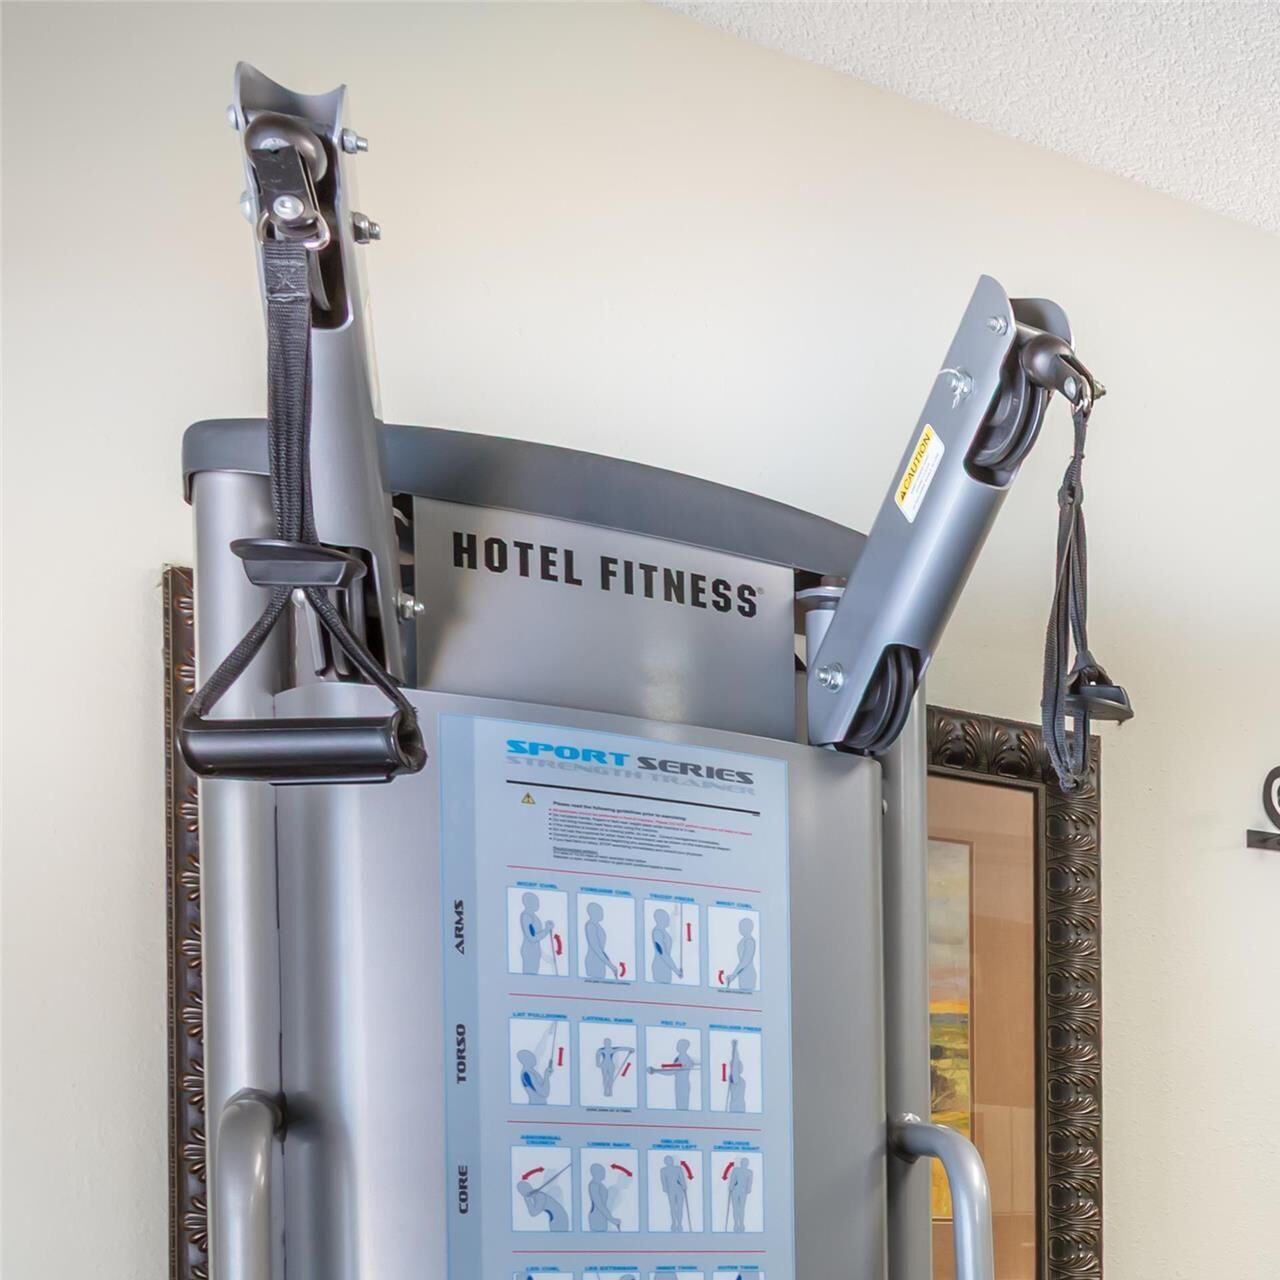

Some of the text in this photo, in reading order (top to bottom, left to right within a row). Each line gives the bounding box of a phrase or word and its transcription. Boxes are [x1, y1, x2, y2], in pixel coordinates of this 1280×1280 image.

[903, 433, 931, 490] CAUTION
[453, 532, 757, 618] HOTEL FITNESS
[506, 739, 754, 785] SPORT SERIES
[506, 755, 756, 795] STRENGTH TRAINER
[455, 899, 465, 955] ARMS
[456, 1024, 466, 1084] TORSO
[458, 1165, 469, 1214] CORE
